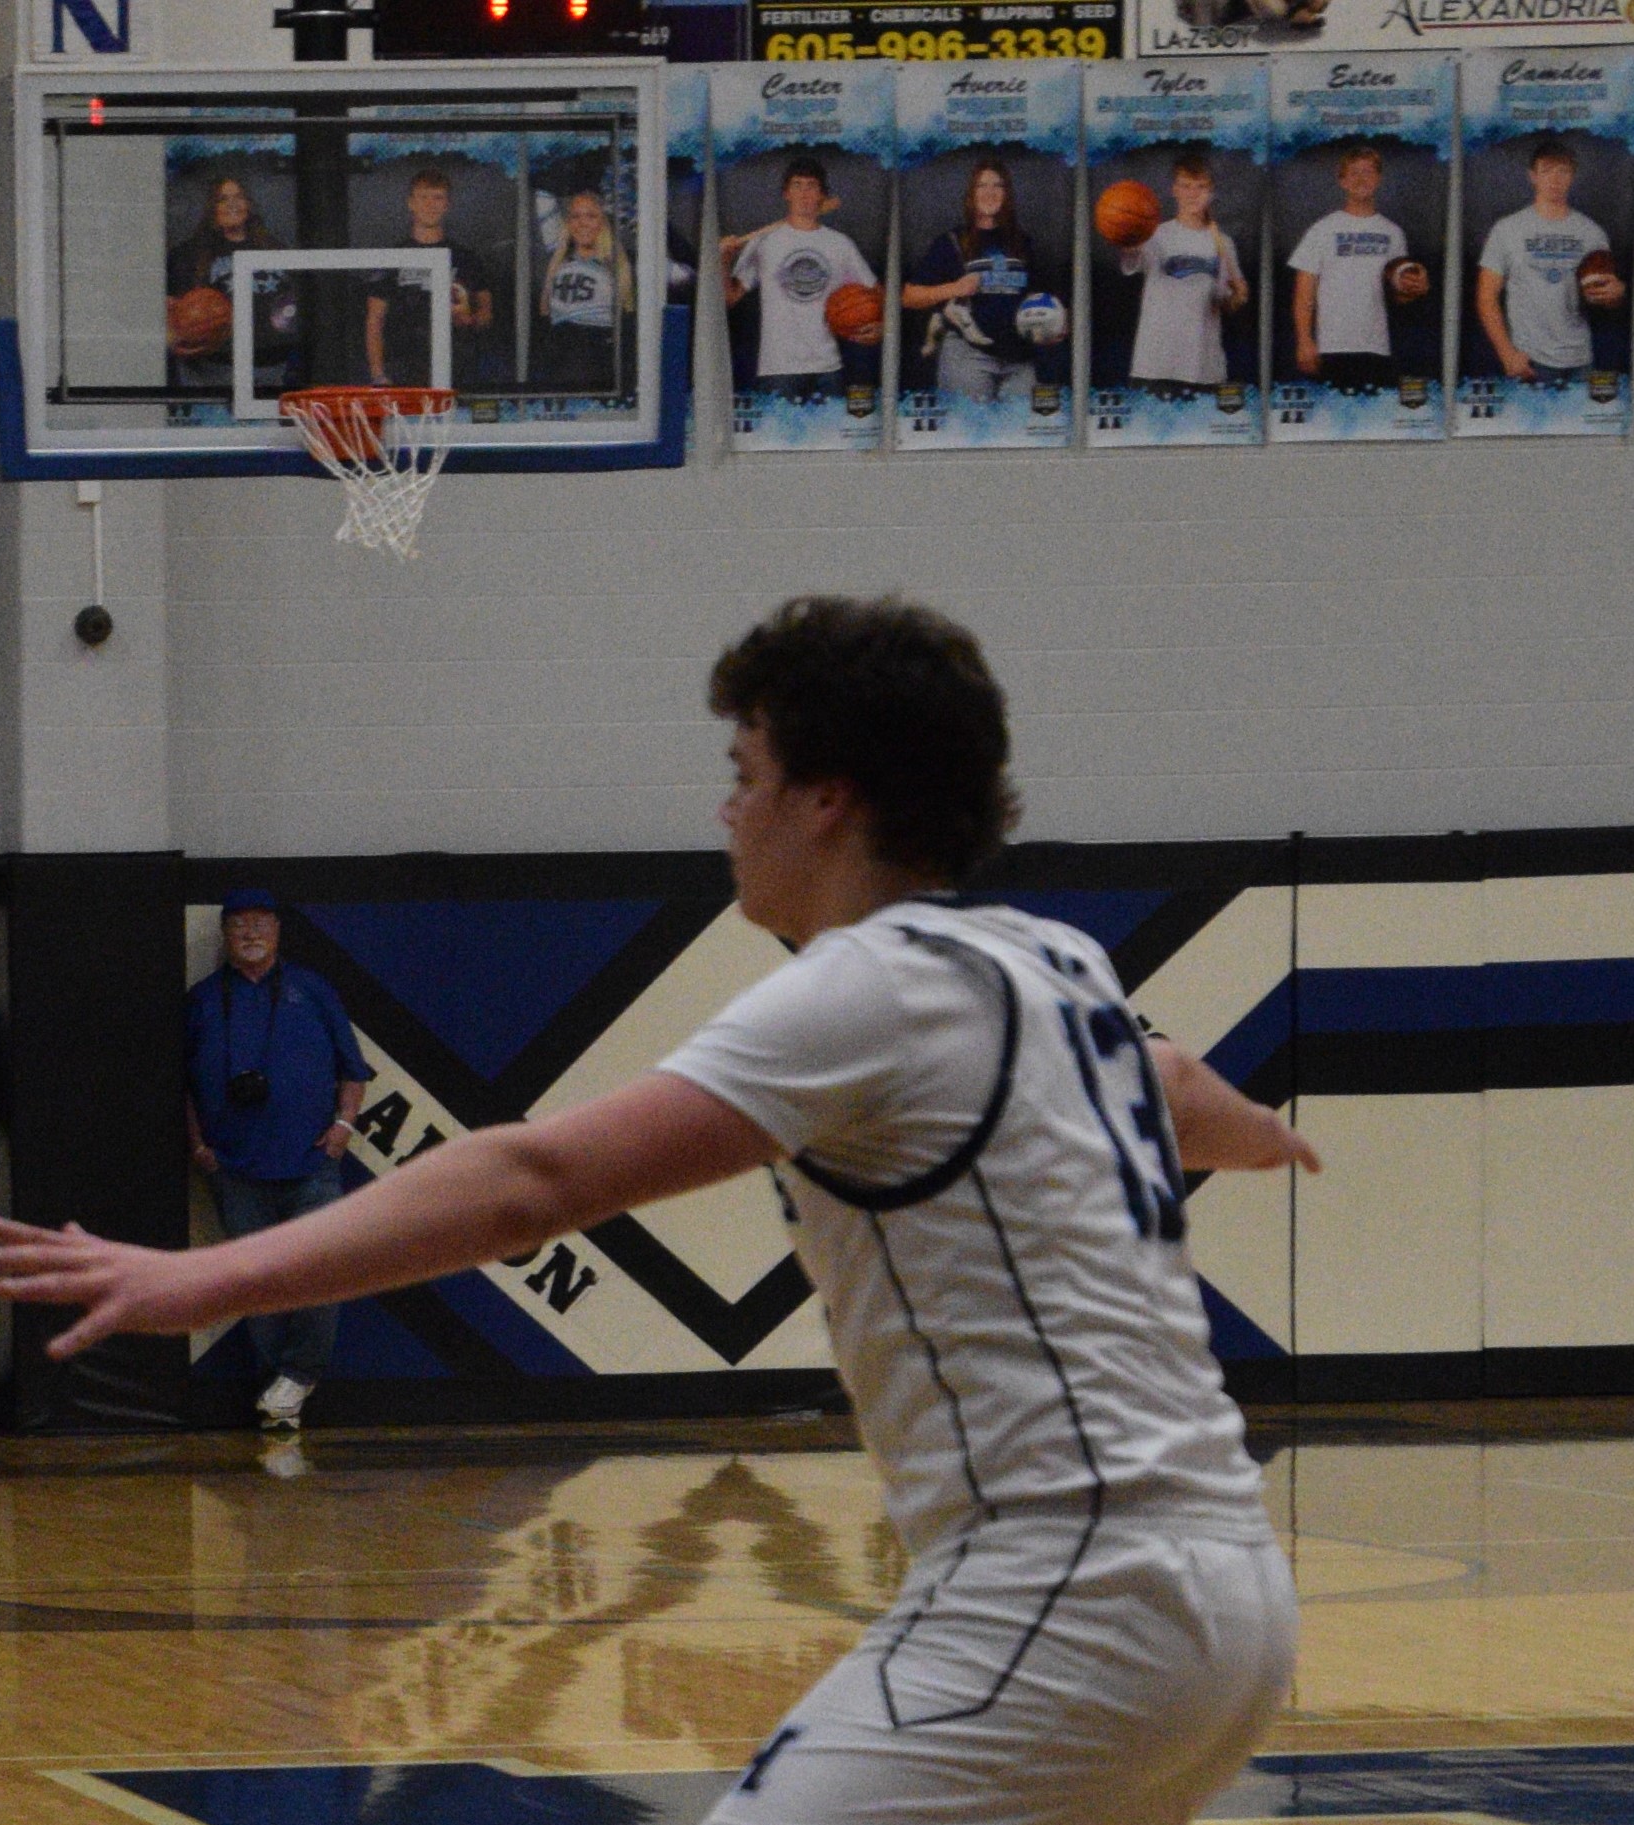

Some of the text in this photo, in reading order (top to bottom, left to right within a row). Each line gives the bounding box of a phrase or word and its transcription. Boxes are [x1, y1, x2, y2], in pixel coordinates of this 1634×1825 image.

[760, 4, 1115, 26] FERTILIZER CHEMICALS MAPPING SEED
[1380, 0, 1622, 36] ALEXANDRIA
[766, 28, 1106, 61] 605-996-3339
[945, 72, 1027, 96] Averie
[1143, 69, 1207, 96] Tyler
[1327, 63, 1397, 89] Esten
[1501, 58, 1603, 85] Camden
[761, 72, 843, 99] Carter
